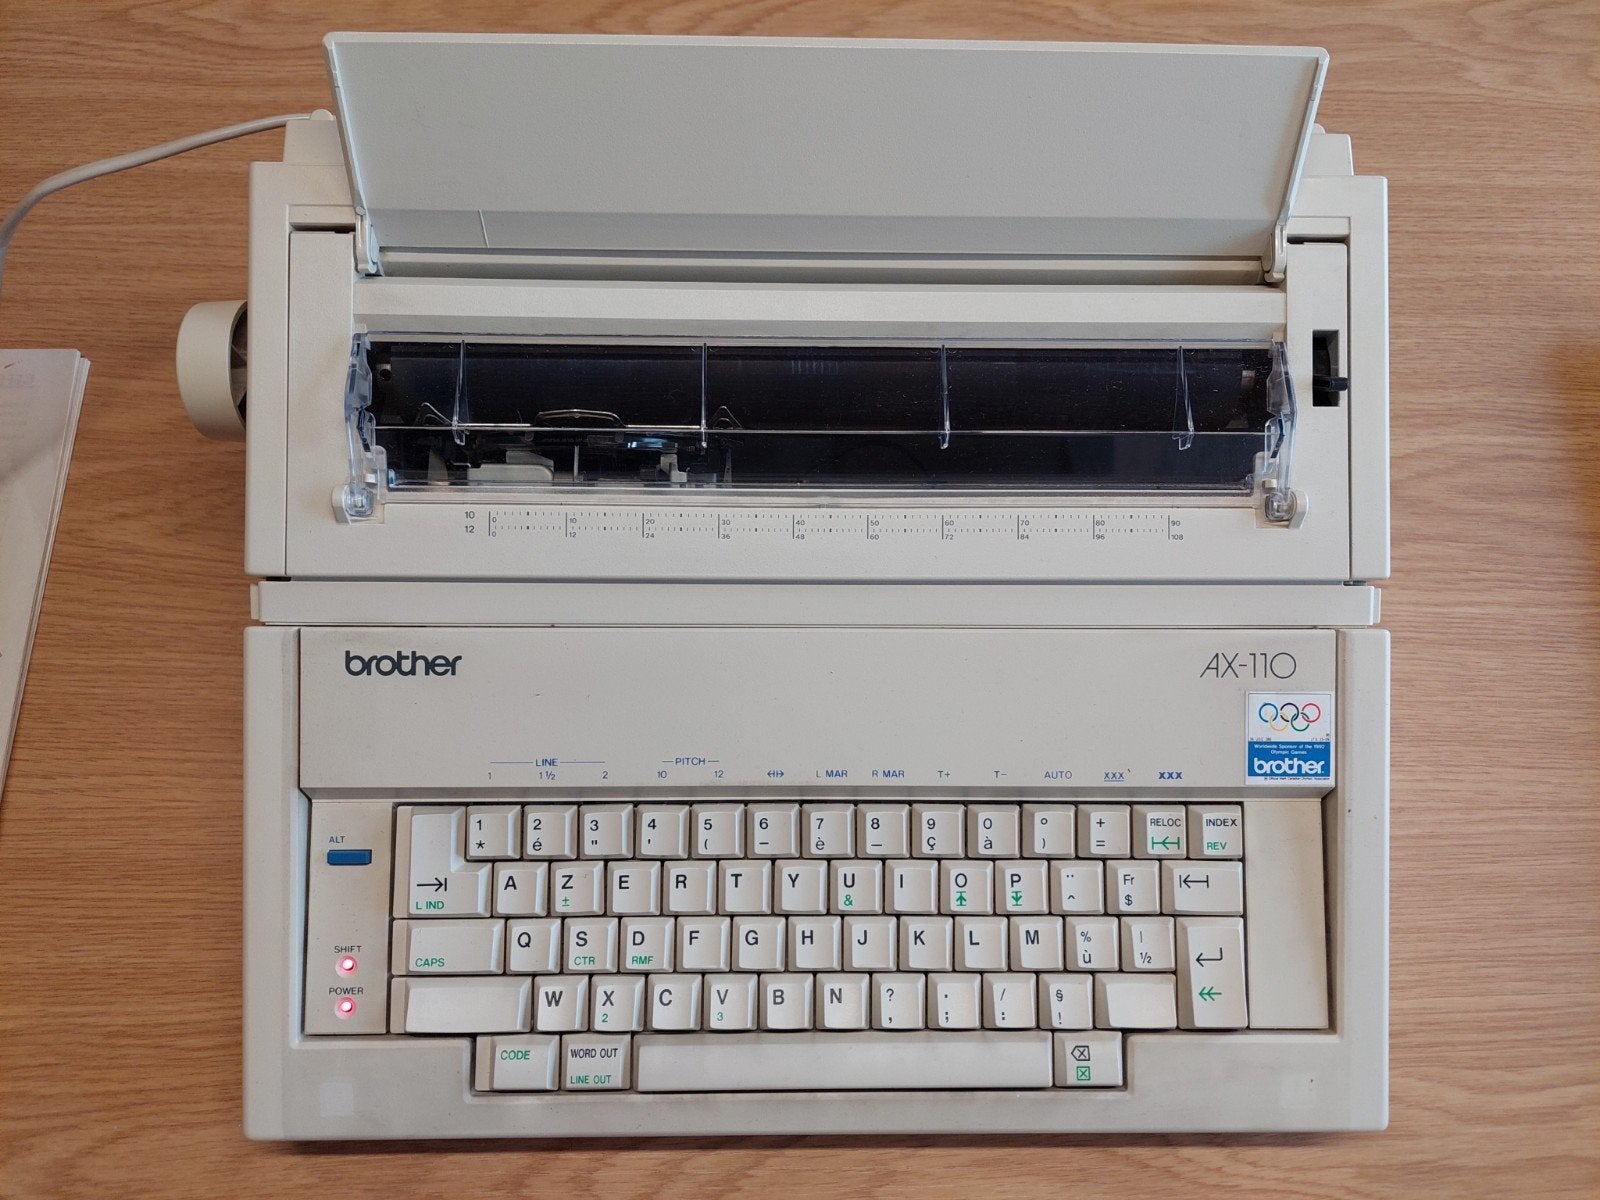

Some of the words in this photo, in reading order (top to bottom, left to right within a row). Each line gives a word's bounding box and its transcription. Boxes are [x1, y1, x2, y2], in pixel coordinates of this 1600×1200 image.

[465, 511, 475, 519] 10
[465, 525, 474, 533] 12
[345, 650, 462, 676] brother
[1200, 652, 1296, 679] AX-110
[675, 757, 705, 765] PITCH
[1254, 758, 1325, 774] brother
[715, 770, 724, 778] 12
[1044, 771, 1072, 780] AUTO
[534, 819, 541, 830] 2
[590, 820, 598, 831] 3
[648, 819, 656, 830] 4
[704, 819, 712, 830] 5
[760, 818, 768, 829] 6
[816, 818, 824, 829] 7
[871, 818, 880, 829] 8
[927, 818, 935, 829] 9
[1150, 818, 1181, 827] RELOC
[533, 838, 542, 851] é
[816, 837, 825, 850] è
[984, 836, 992, 849] à
[1207, 842, 1227, 850] REV
[504, 876, 517, 890] A
[562, 875, 573, 889] Z
[619, 875, 629, 889] E
[676, 875, 687, 888] R
[731, 874, 742, 888] T
[788, 874, 799, 888] Y
[844, 873, 855, 888] U
[955, 873, 967, 888] O
[1011, 874, 1021, 887] P
[1124, 874, 1134, 885] Fr
[416, 902, 422, 910] L
[426, 901, 444, 909] IND
[844, 895, 853, 906] &
[1125, 894, 1132, 906] $
[518, 932, 531, 948] Q
[576, 931, 587, 947] S
[633, 931, 644, 945] D
[690, 930, 699, 945] F
[745, 930, 758, 945] G
[802, 930, 813, 945] H
[858, 930, 867, 945] J
[914, 931, 925, 945] K
[969, 931, 979, 945] L
[1026, 930, 1039, 945] M
[1080, 931, 1091, 942] %
[415, 958, 444, 967] CAPS
[574, 956, 595, 965] CTR
[632, 956, 653, 964] RMF
[1083, 950, 1091, 964] ù
[329, 987, 363, 996] POWER
[659, 989, 672, 1006] C
[717, 989, 728, 1005] V
[773, 989, 784, 1005] B
[830, 988, 842, 1004] N
[886, 988, 894, 1001] ?
[545, 991, 563, 1007] W
[602, 991, 614, 1006] X
[602, 1013, 608, 1022] 2
[717, 1012, 723, 1021] 3
[501, 1050, 530, 1060] CODE
[571, 1049, 596, 1058] WORD
[600, 1048, 618, 1058] OUT
[571, 1076, 589, 1084] LINE
[593, 1075, 612, 1085] OUT
